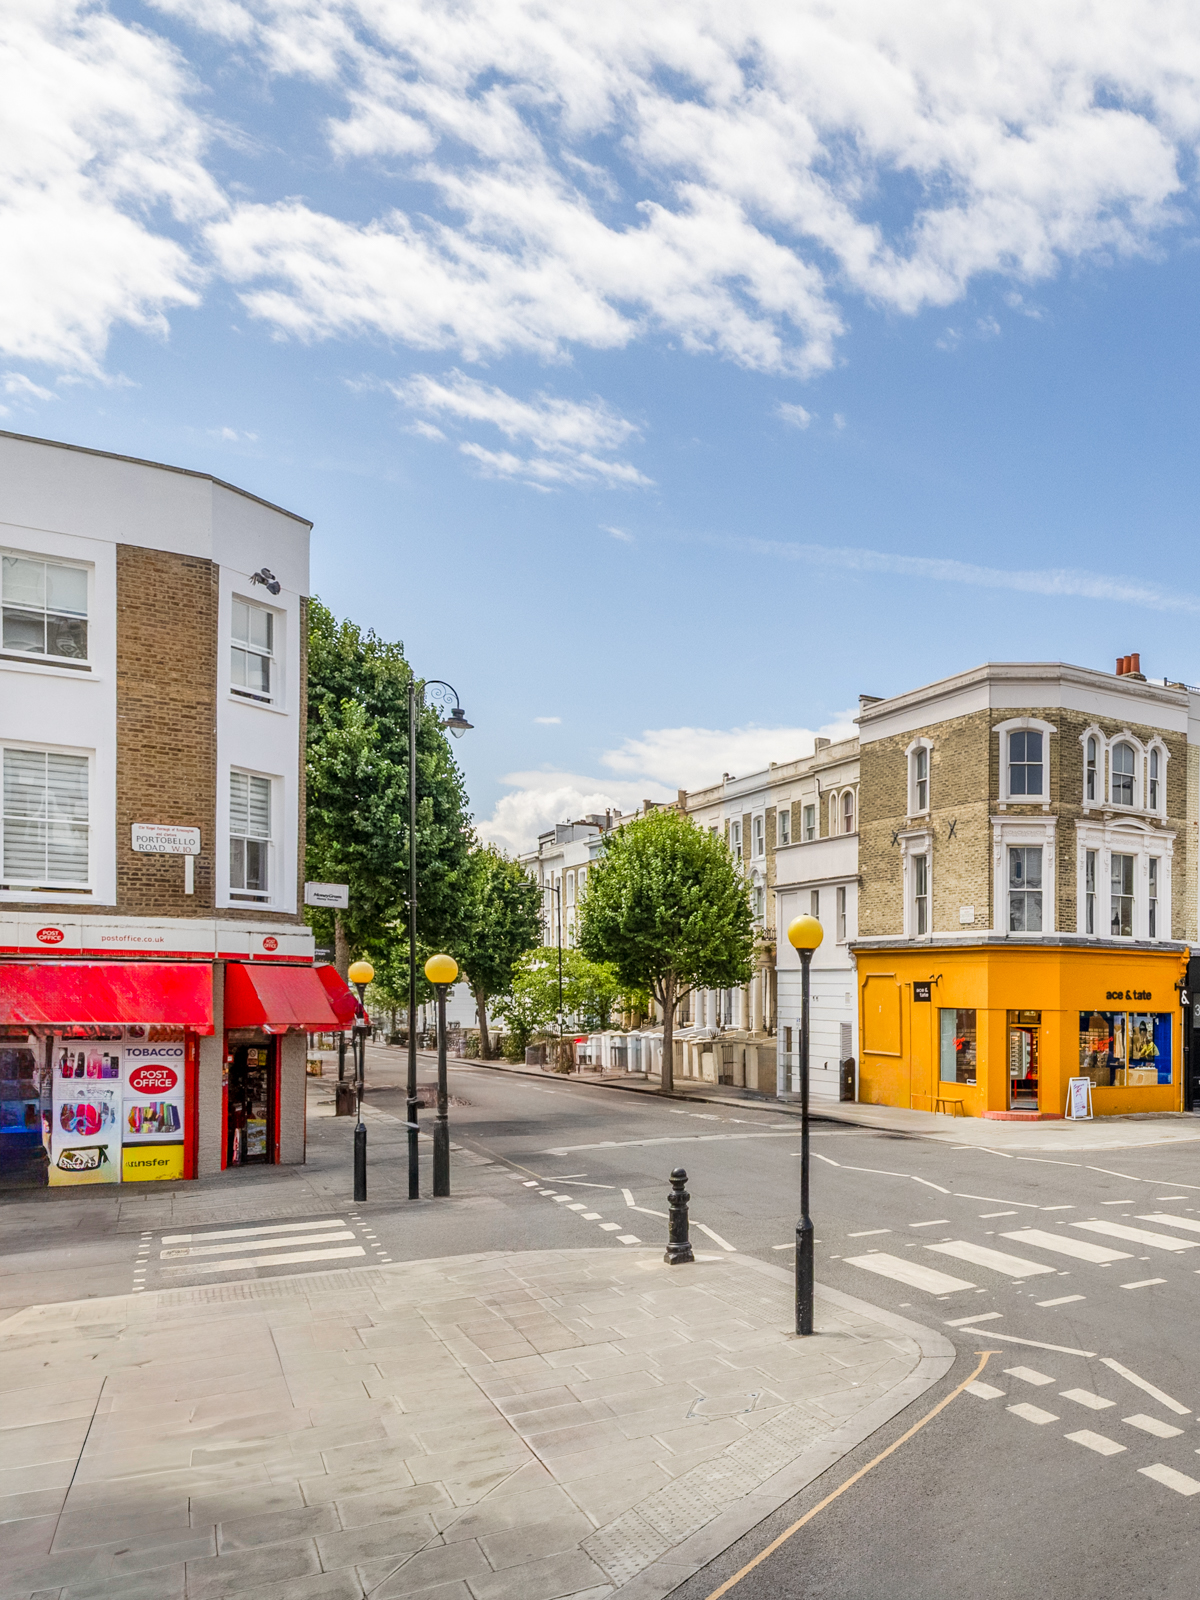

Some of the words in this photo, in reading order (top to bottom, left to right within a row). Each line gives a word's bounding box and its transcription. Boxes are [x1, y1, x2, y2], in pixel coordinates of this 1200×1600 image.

[136, 835, 196, 845] PORTOBELLO
[101, 934, 164, 942] postoffice.co.uk
[1106, 991, 1123, 1000] ace
[1125, 990, 1132, 1000] &
[1133, 990, 1152, 1000] tate
[1181, 990, 1190, 1004] &
[126, 1048, 183, 1056] TOBACCO
[140, 1070, 168, 1079] POST
[133, 1079, 172, 1087] OFFICE
